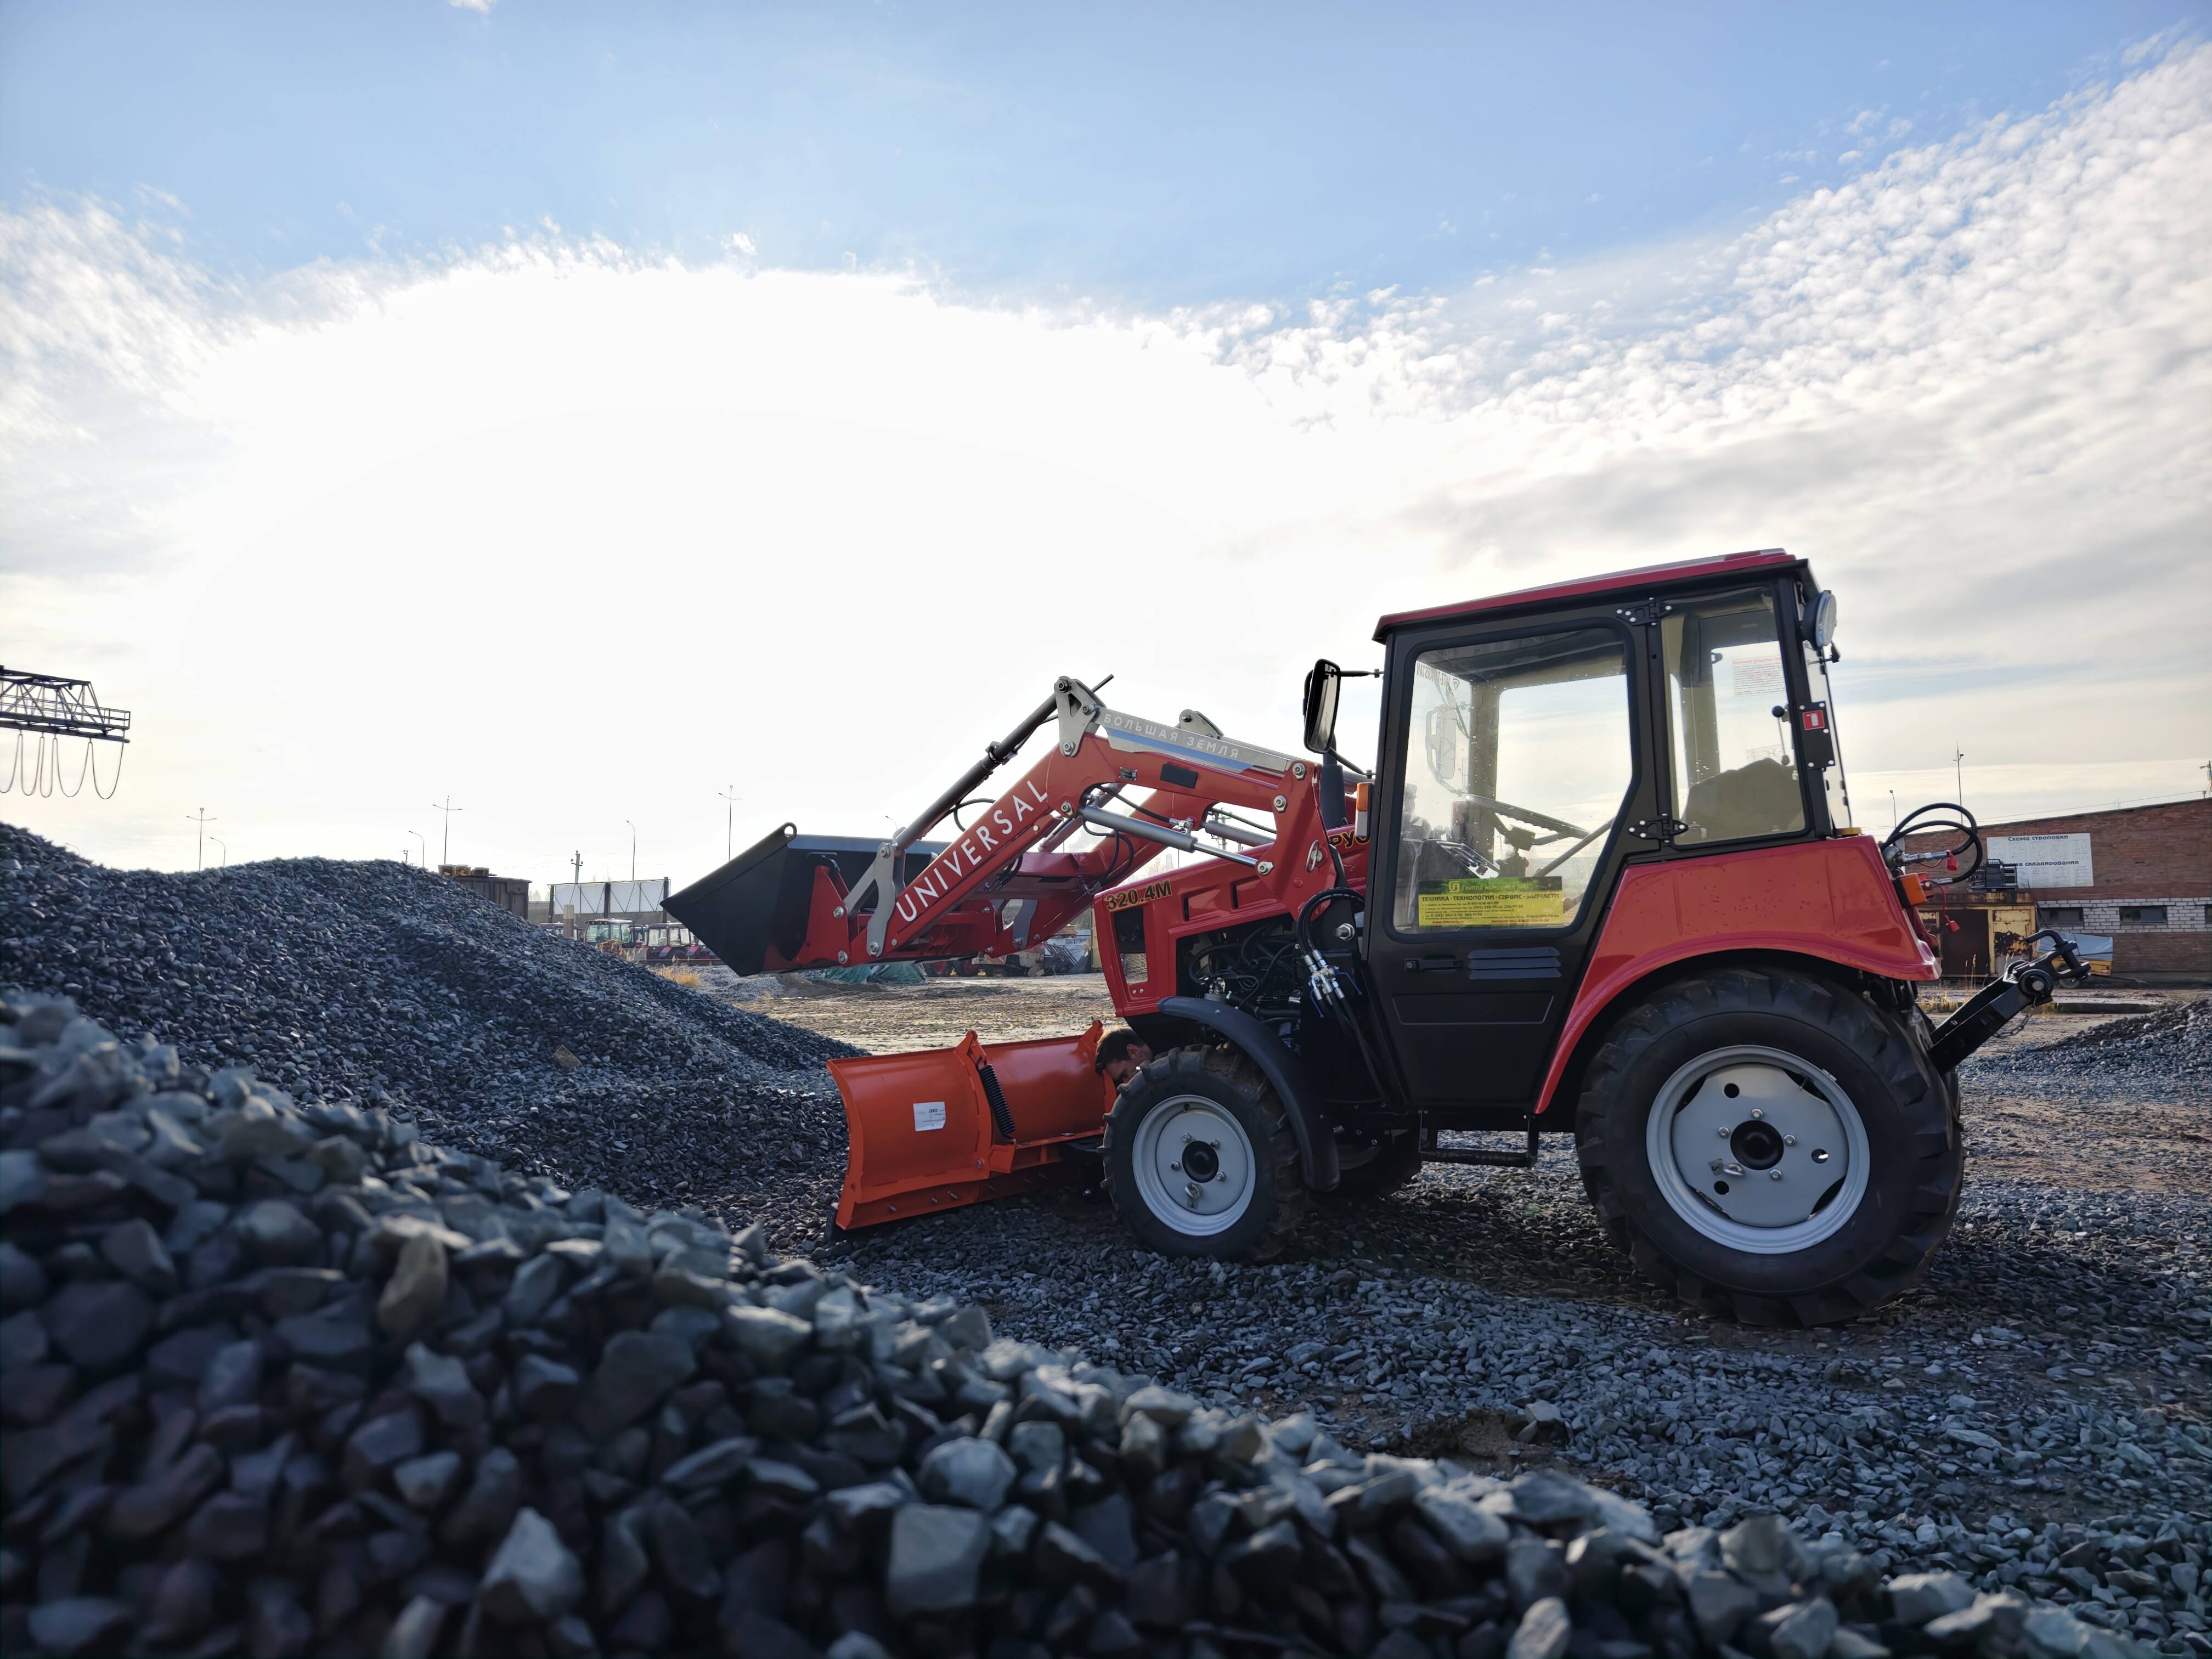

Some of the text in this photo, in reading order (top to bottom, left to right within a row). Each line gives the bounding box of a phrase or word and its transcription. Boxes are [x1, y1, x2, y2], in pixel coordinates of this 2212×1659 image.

[1104, 713, 1239, 759] БОЛЬШАЯ ЗЕМЛЯ
[895, 780, 1048, 922] UNIVERSAL
